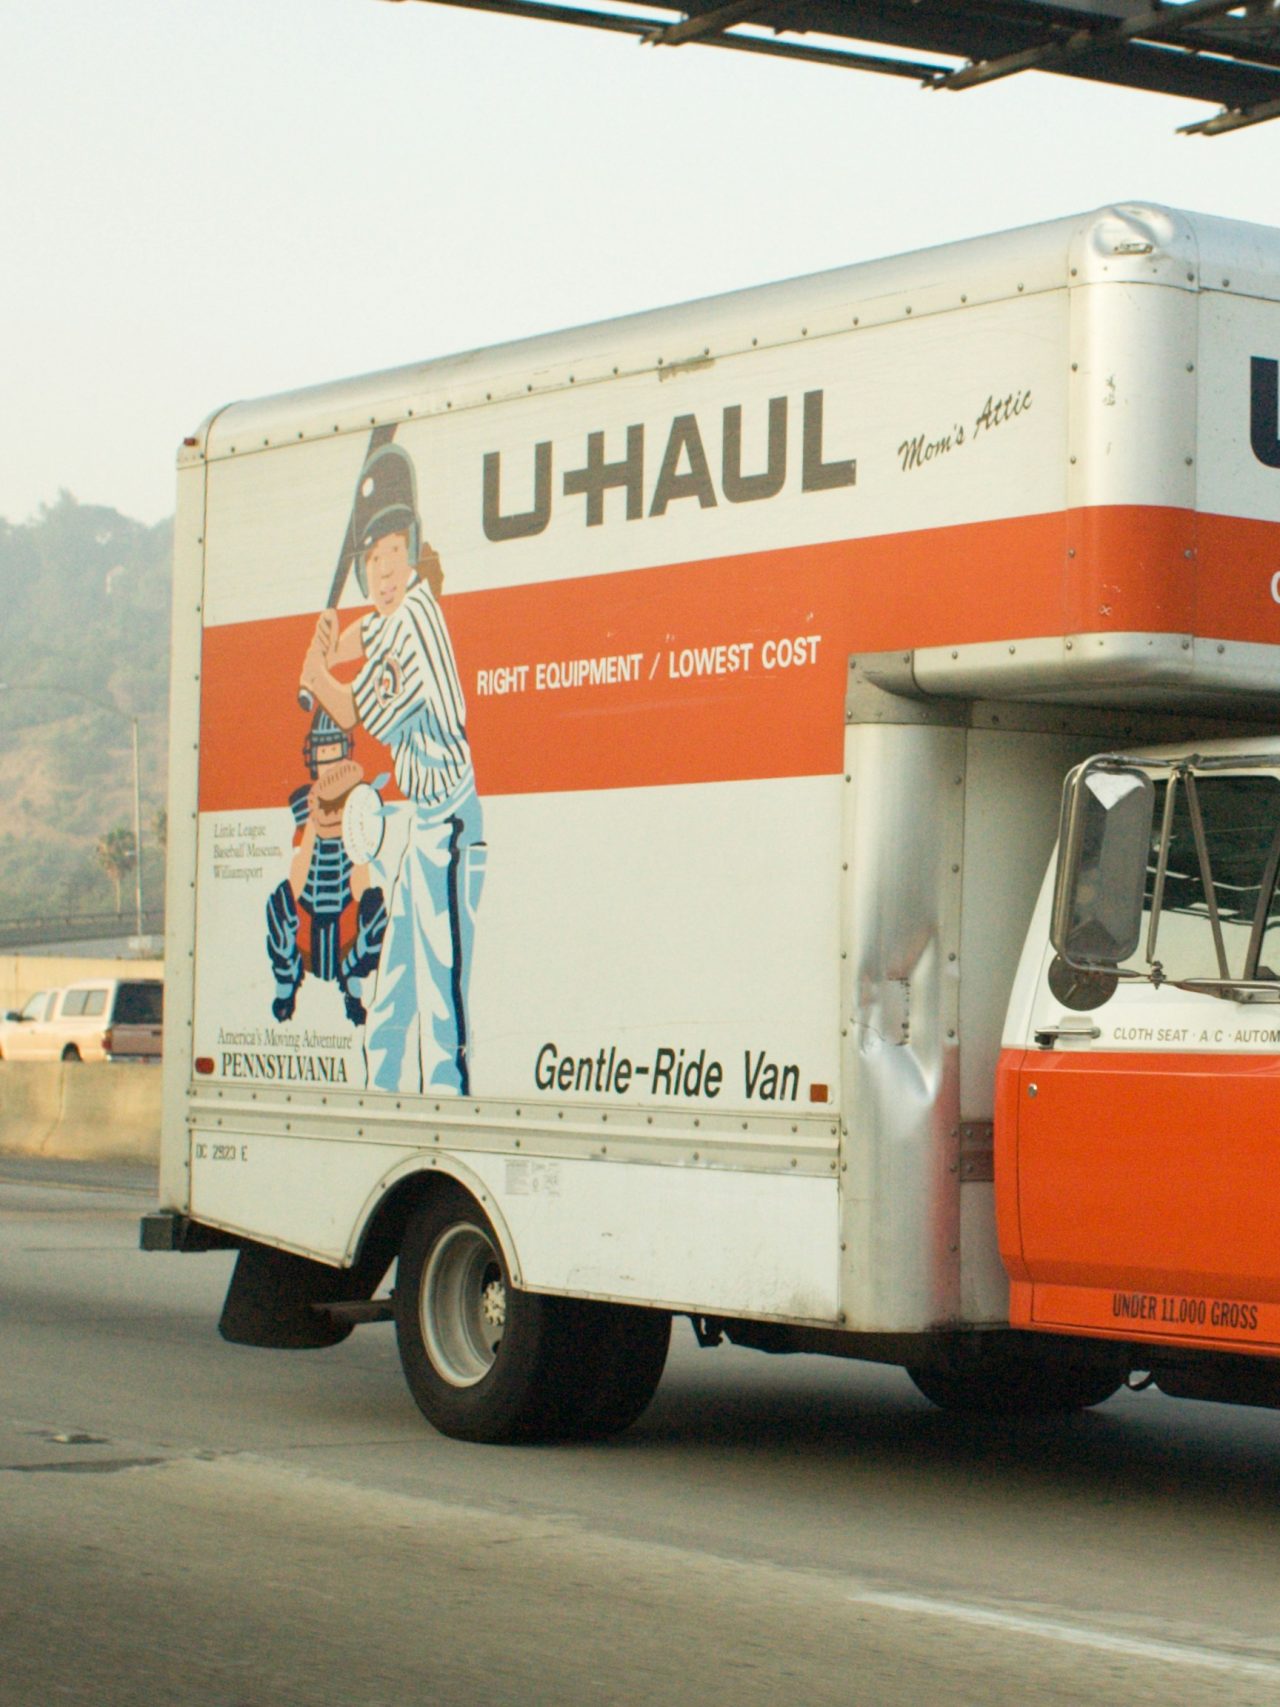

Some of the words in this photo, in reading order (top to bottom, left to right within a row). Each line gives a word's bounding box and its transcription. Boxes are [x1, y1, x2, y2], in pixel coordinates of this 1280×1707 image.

[897, 423, 965, 472] Mom's
[972, 389, 1032, 440] Attic
[482, 389, 857, 543] U-HAUL
[477, 665, 529, 696] RIGHT
[535, 653, 643, 691] EQUIPMENT
[669, 643, 754, 679] LOWEST
[761, 636, 822, 670] COST
[238, 822, 266, 841] League
[217, 1027, 260, 1046] America's
[264, 1028, 300, 1052] Moving
[302, 1029, 352, 1050] Adventure
[1113, 1027, 1153, 1041] CLOTH
[1157, 1028, 1189, 1042] SEAT
[222, 1052, 347, 1082] PENNSYLVANIA
[535, 1042, 723, 1099] Gentle-Ride
[744, 1050, 800, 1101] Van
[1112, 1293, 1157, 1320] UNDER
[1211, 1301, 1258, 1330] GROSS
